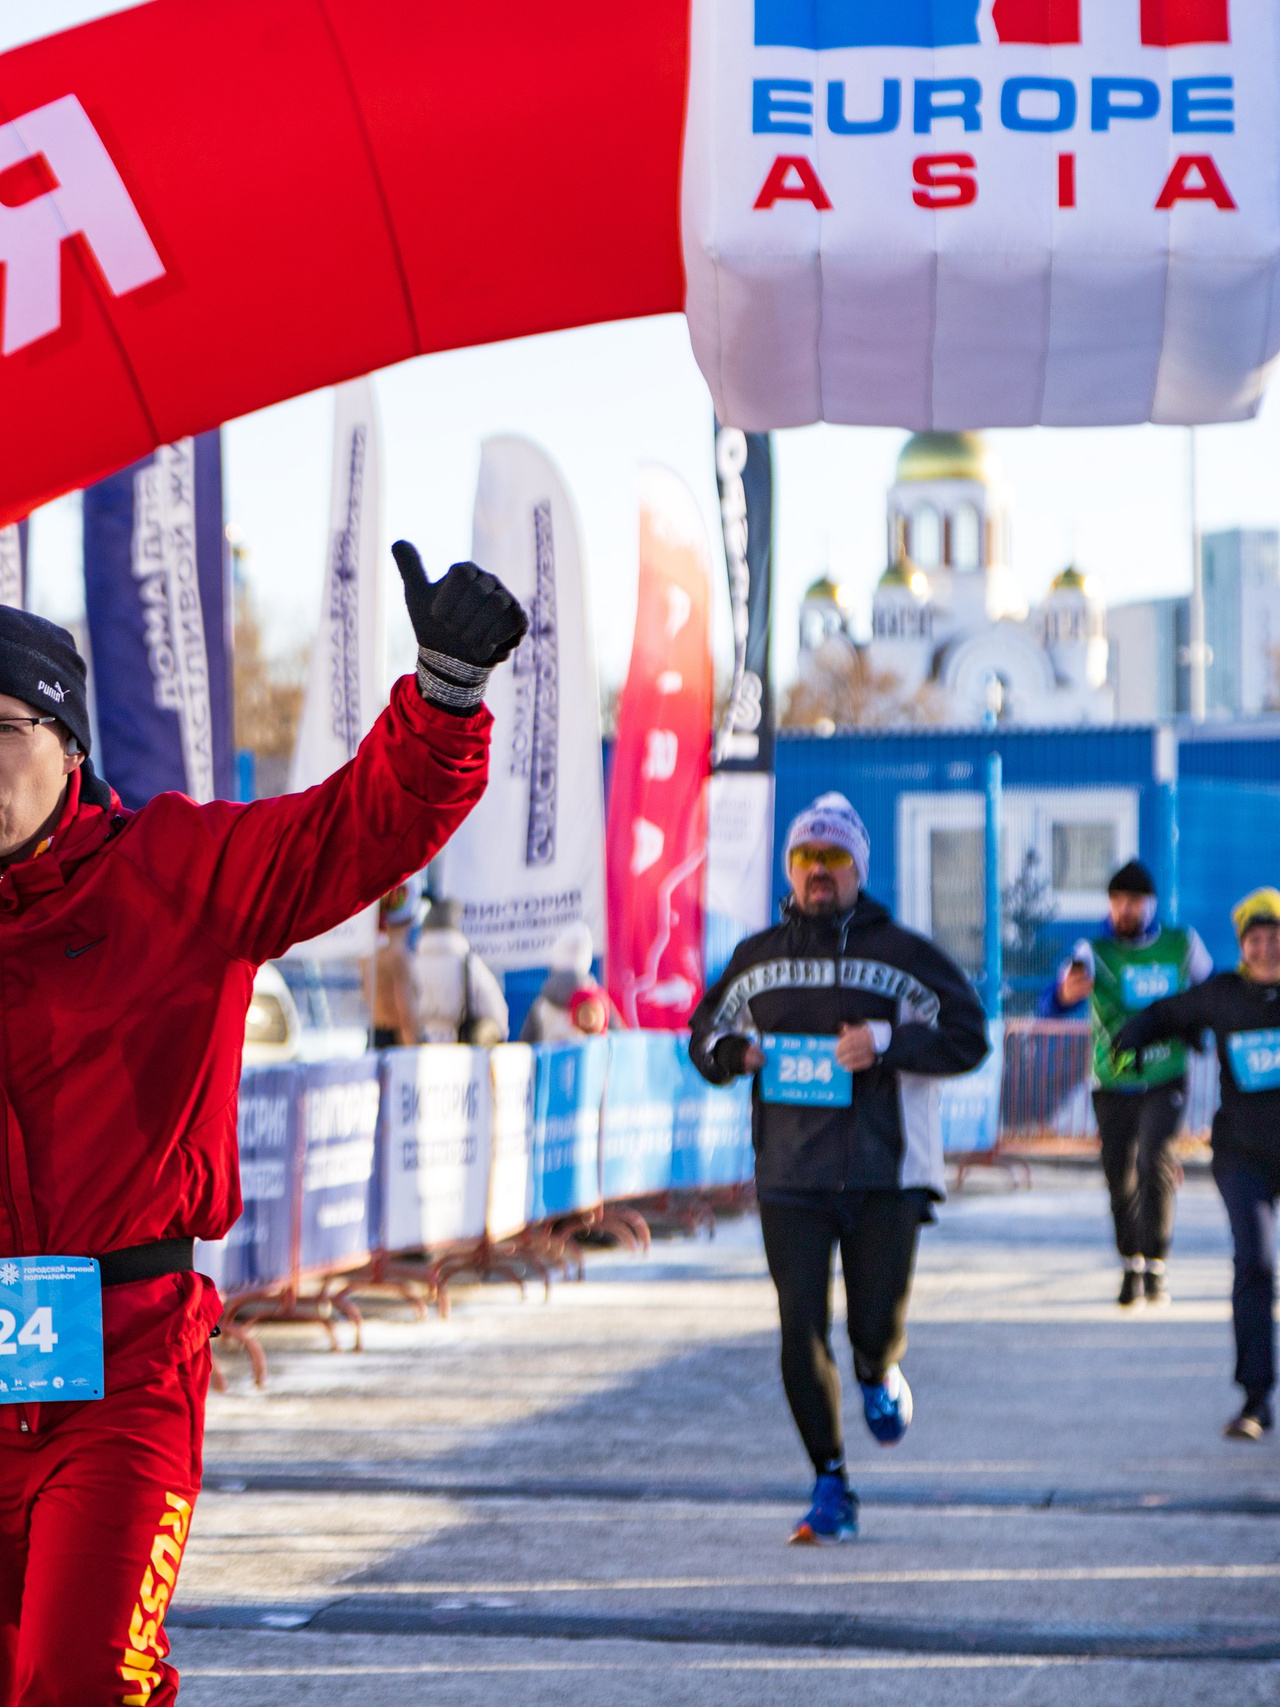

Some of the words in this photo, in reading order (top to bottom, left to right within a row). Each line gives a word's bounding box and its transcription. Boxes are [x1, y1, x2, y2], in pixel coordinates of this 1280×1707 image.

[752, 75, 1235, 136] EUROPE
[752, 151, 1239, 211] ASIA
[24, 1265, 65, 1274] ГОРОДСКОЙ
[24, 1273, 76, 1281] ПОЛУМАРАФОН
